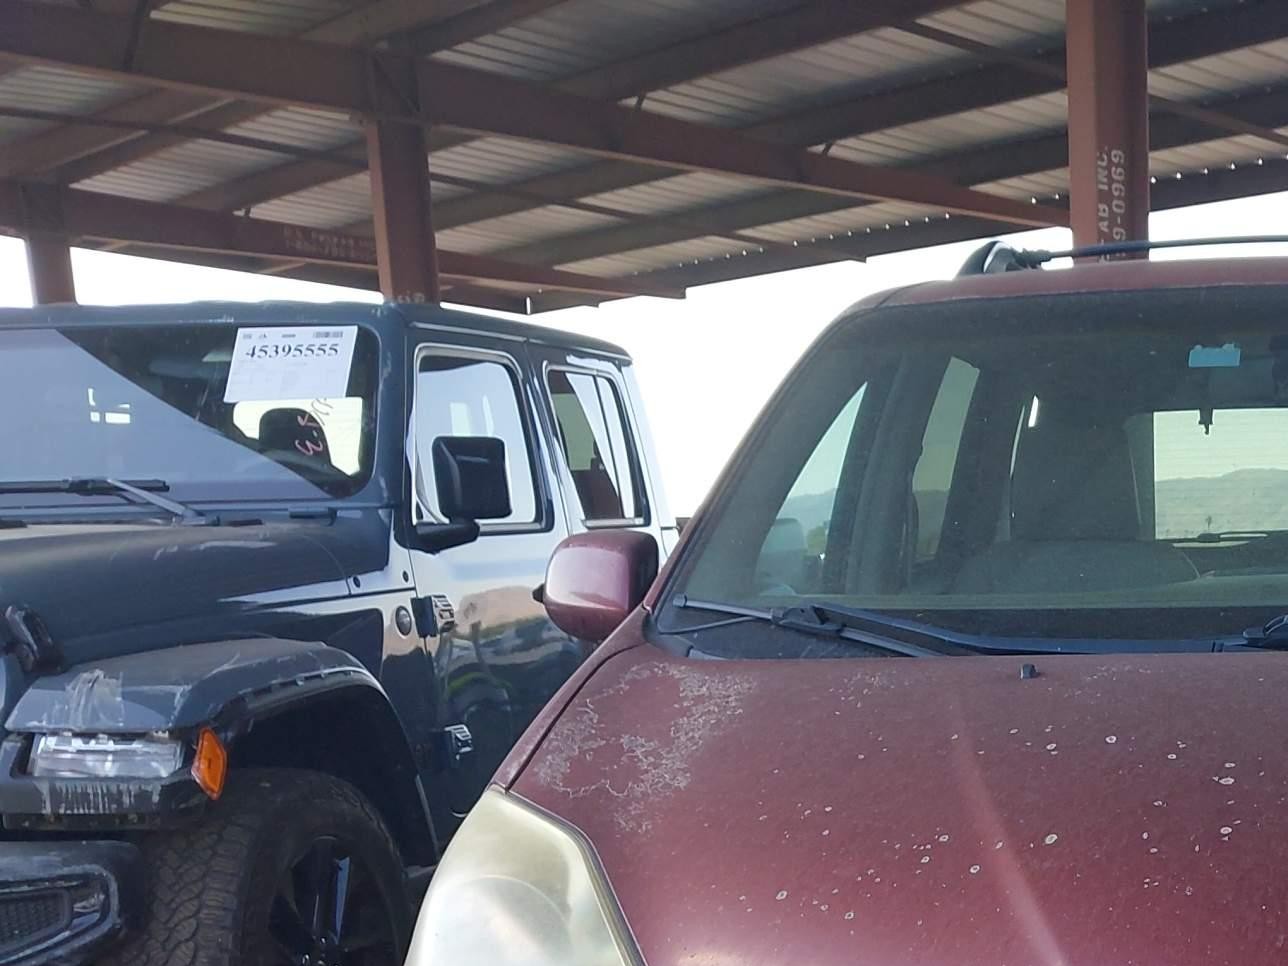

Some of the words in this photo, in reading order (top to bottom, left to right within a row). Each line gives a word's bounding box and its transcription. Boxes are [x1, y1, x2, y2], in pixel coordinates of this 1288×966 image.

[1096, 146, 1109, 191] INC.
[1110, 149, 1127, 257] 9-0969
[245, 343, 340, 359] 45395555
